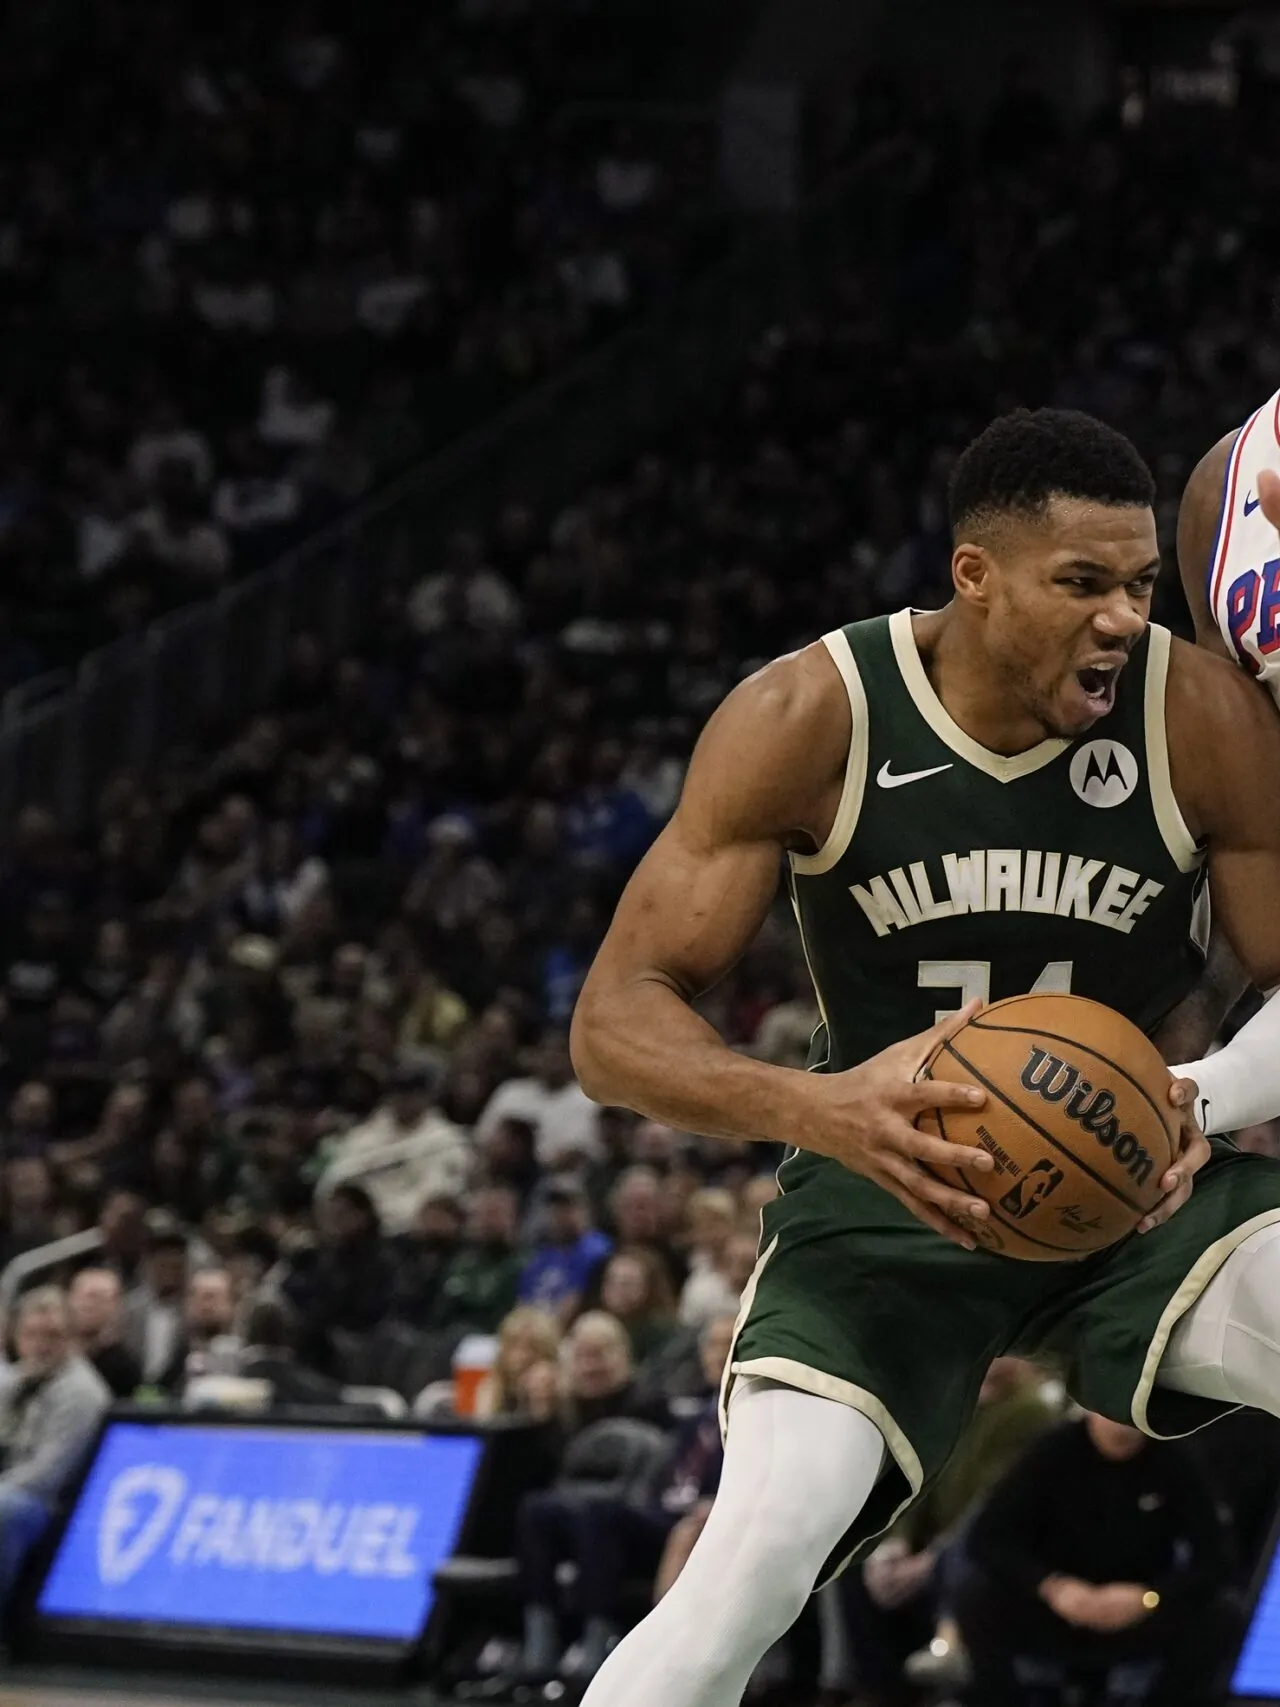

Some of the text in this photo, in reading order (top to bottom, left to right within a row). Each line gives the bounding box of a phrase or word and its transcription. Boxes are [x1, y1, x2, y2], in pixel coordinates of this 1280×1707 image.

[849, 849, 1165, 938] MILWAUKEE
[1019, 1045, 1154, 1187] Wilson
[171, 1494, 421, 1577] FANDUEL
